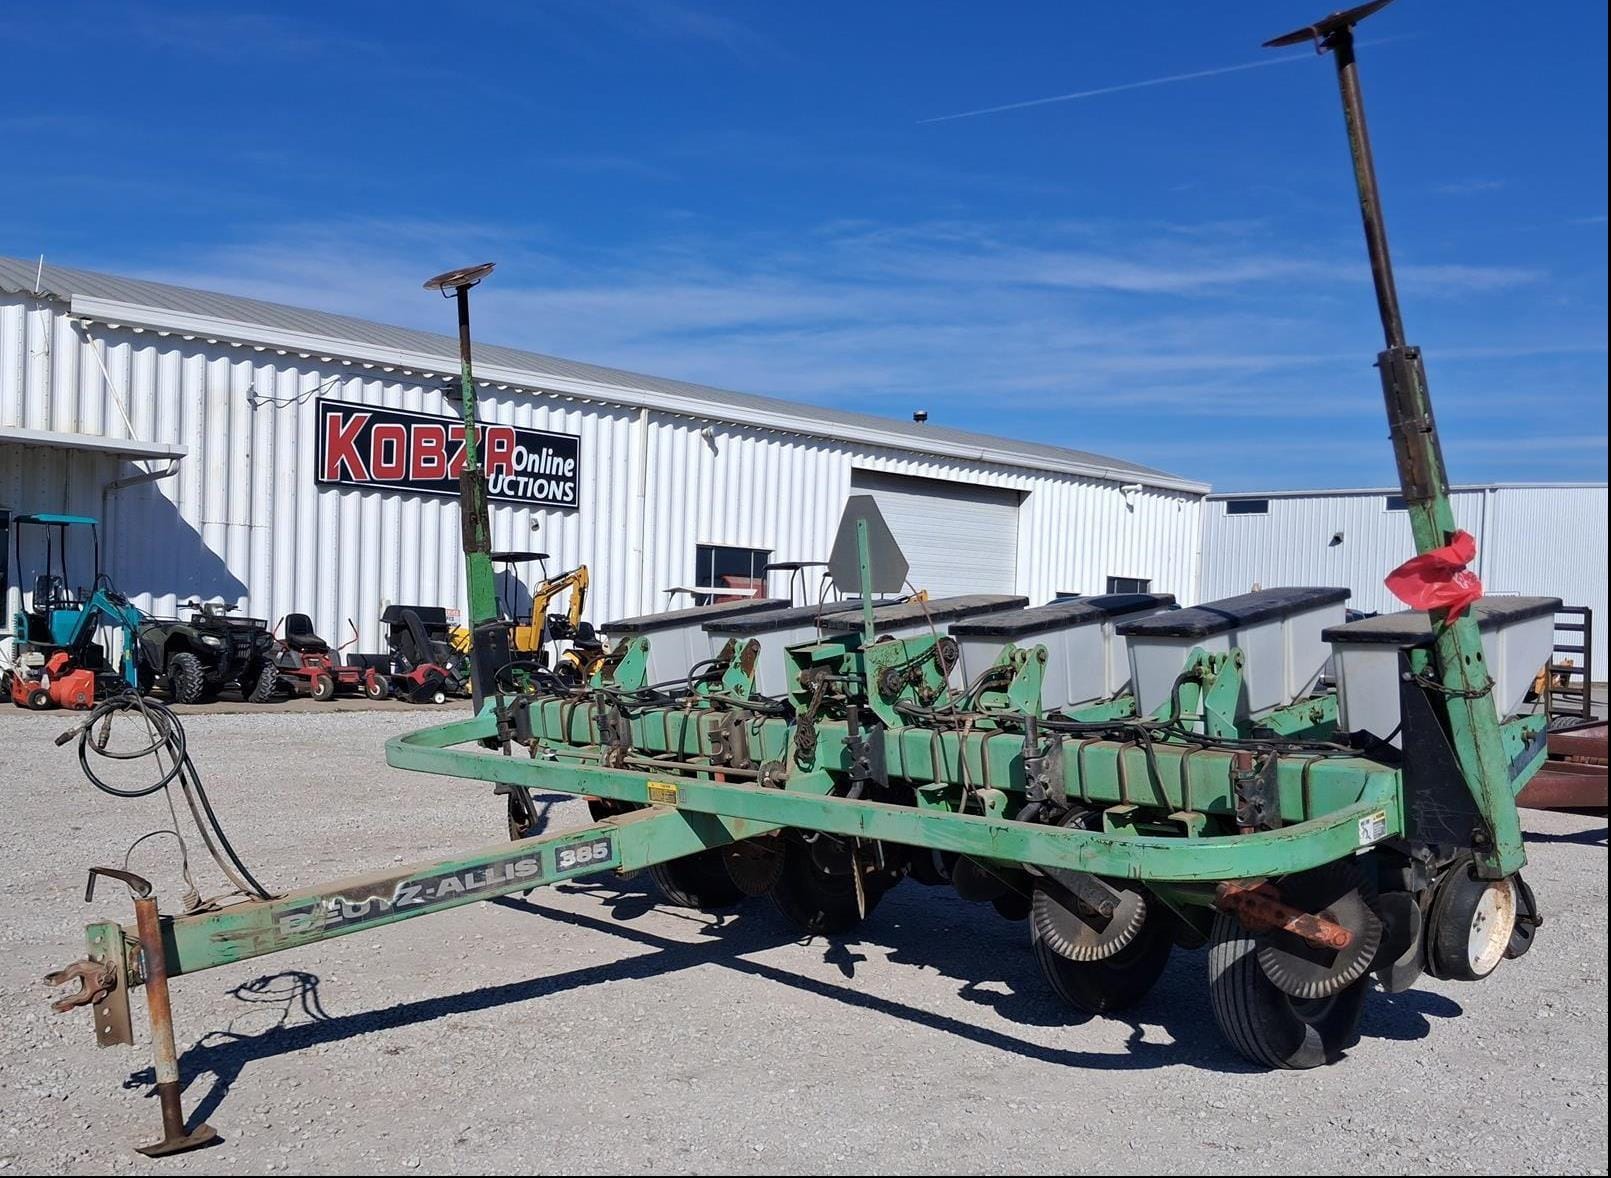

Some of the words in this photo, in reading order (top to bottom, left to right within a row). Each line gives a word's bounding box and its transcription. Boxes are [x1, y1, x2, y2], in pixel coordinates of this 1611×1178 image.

[324, 412, 515, 481] KOBZA
[511, 445, 574, 476] Online
[487, 472, 574, 501] UCTIONS
[559, 843, 608, 868] 385
